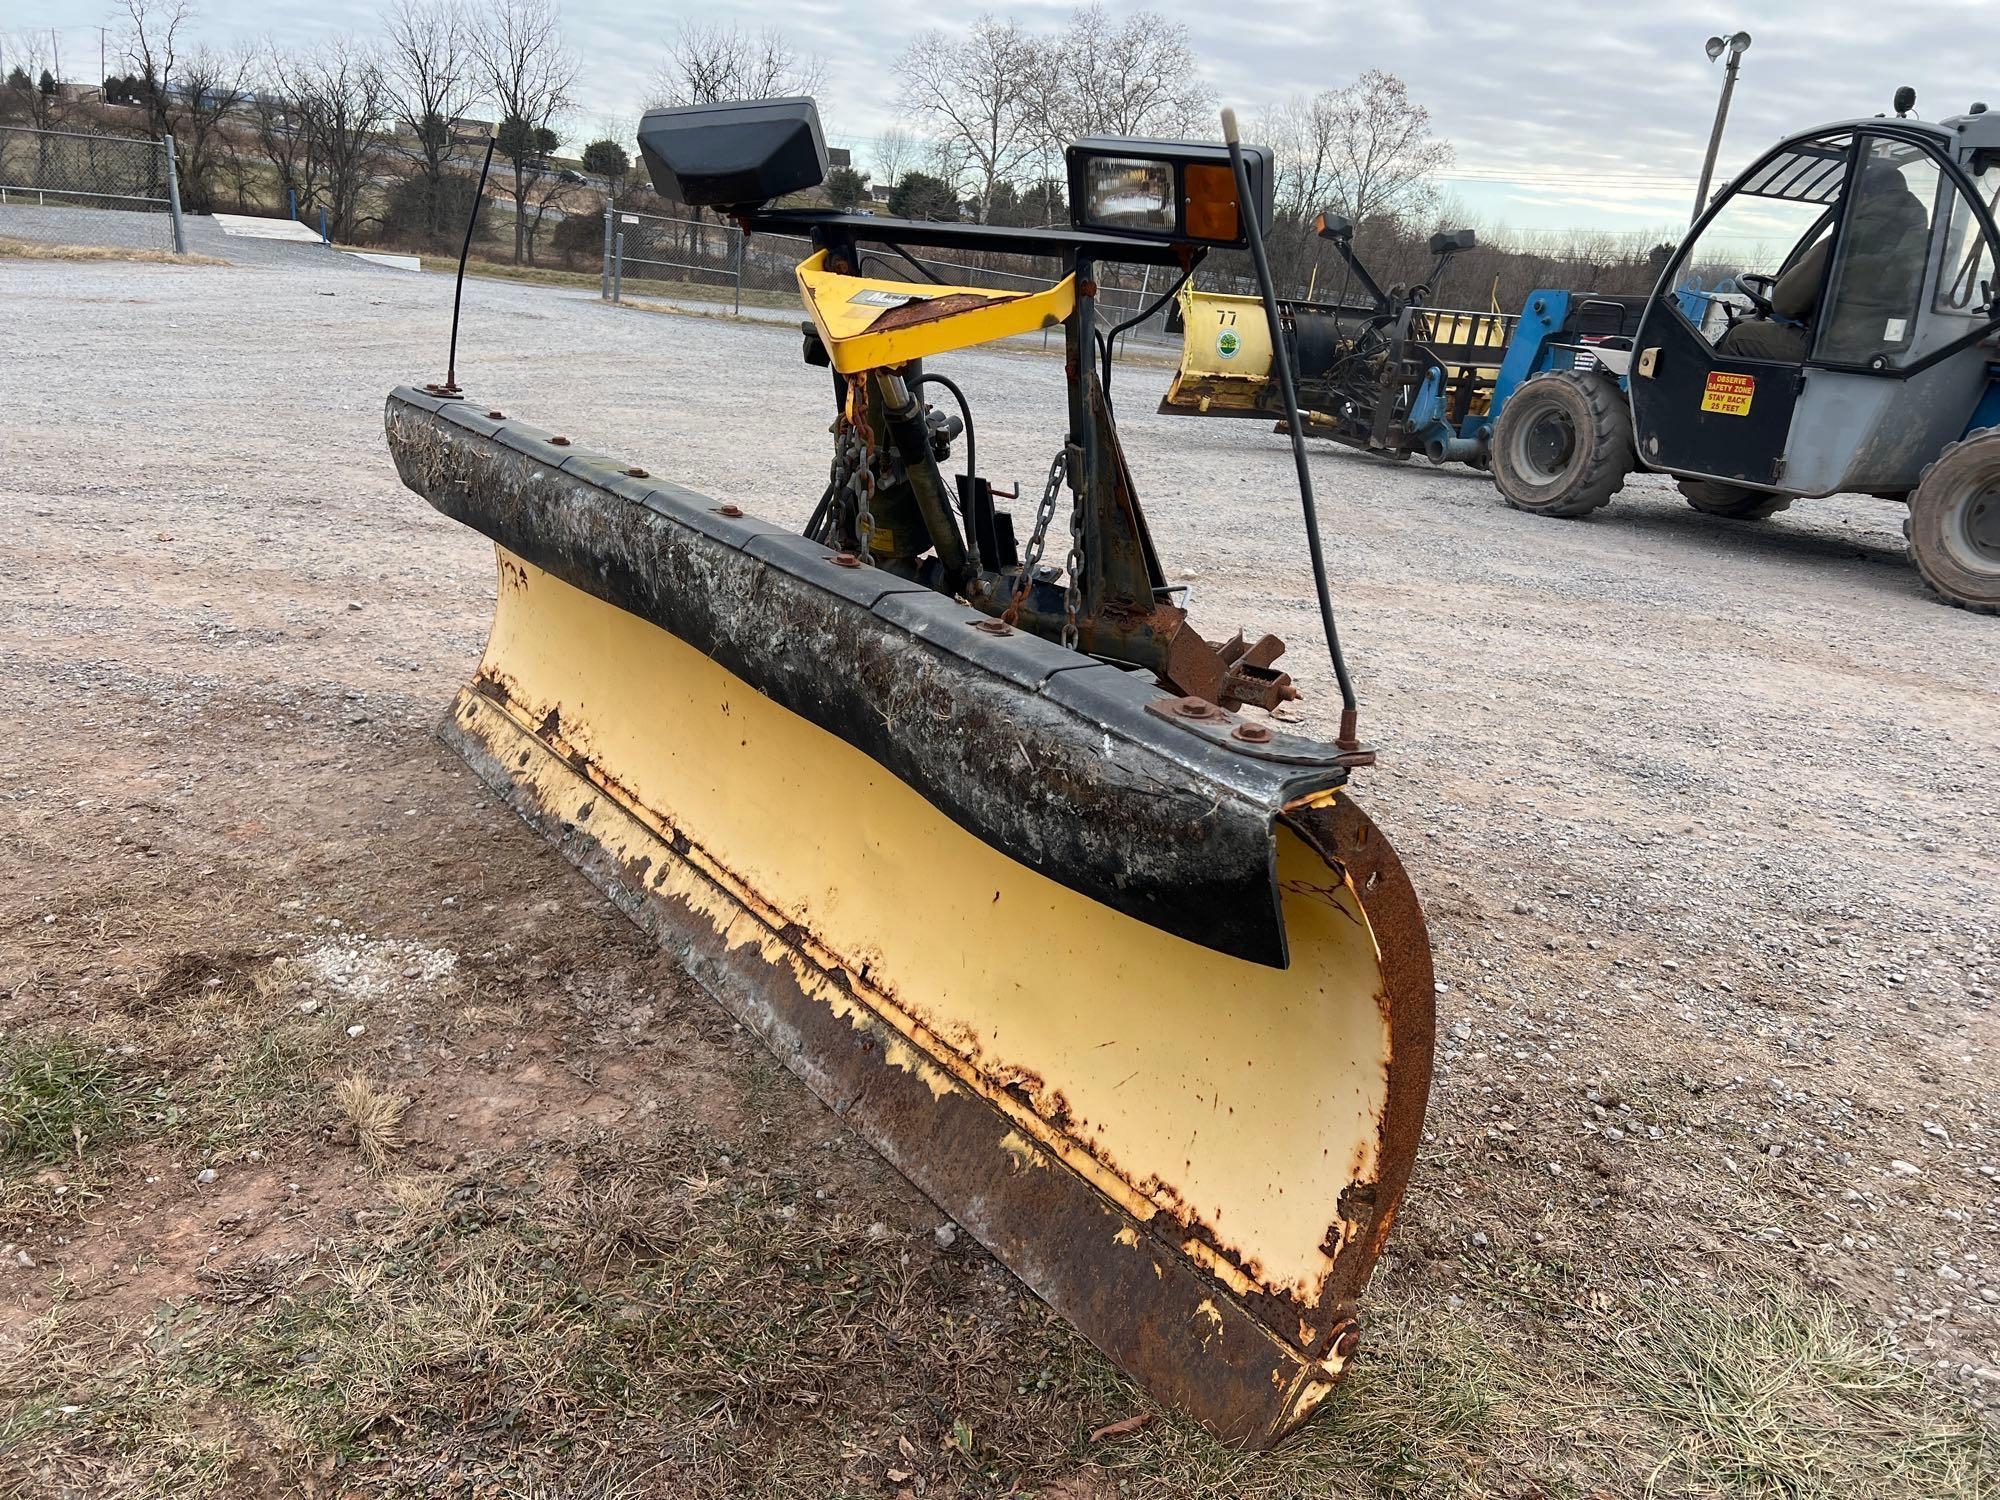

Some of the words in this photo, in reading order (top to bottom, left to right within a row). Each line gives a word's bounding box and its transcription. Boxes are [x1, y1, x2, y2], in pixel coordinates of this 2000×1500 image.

[1217, 310, 1236, 325] 77
[1717, 376, 1747, 385] OBSERVE
[1707, 383, 1733, 391] SAFETY
[1734, 386, 1752, 394] ZONE
[1727, 396, 1746, 404] BACK
